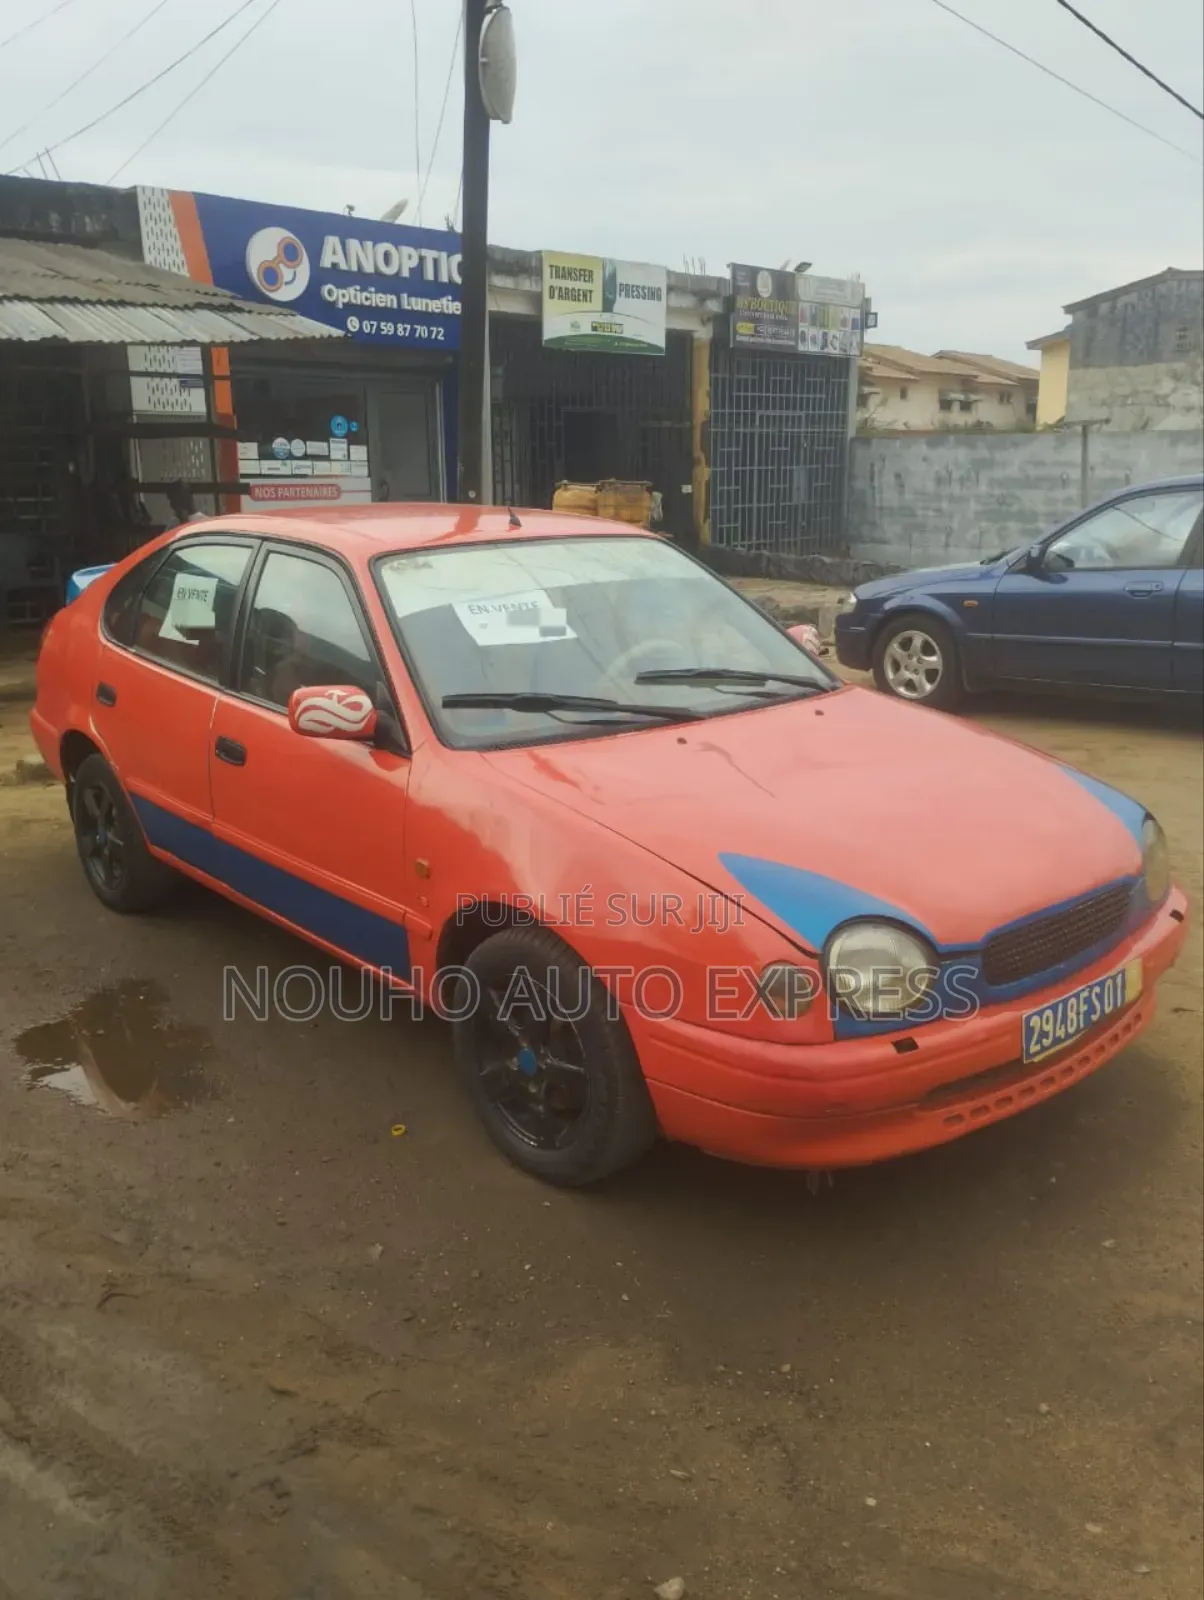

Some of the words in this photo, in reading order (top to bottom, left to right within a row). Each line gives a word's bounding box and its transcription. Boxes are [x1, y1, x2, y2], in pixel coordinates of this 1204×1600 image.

[549, 264, 594, 284] TRANSFER
[321, 283, 398, 309] Opticien
[549, 285, 594, 304] D'ARGENT
[618, 283, 662, 302] PRESSING
[362, 320, 378, 334] 07
[380, 321, 395, 335] 59
[396, 323, 411, 337] 87
[413, 325, 429, 339] 70
[430, 326, 445, 340] 72
[254, 486, 276, 499] NOS
[278, 486, 338, 499] PARTENAIRES
[468, 602, 490, 615] EN
